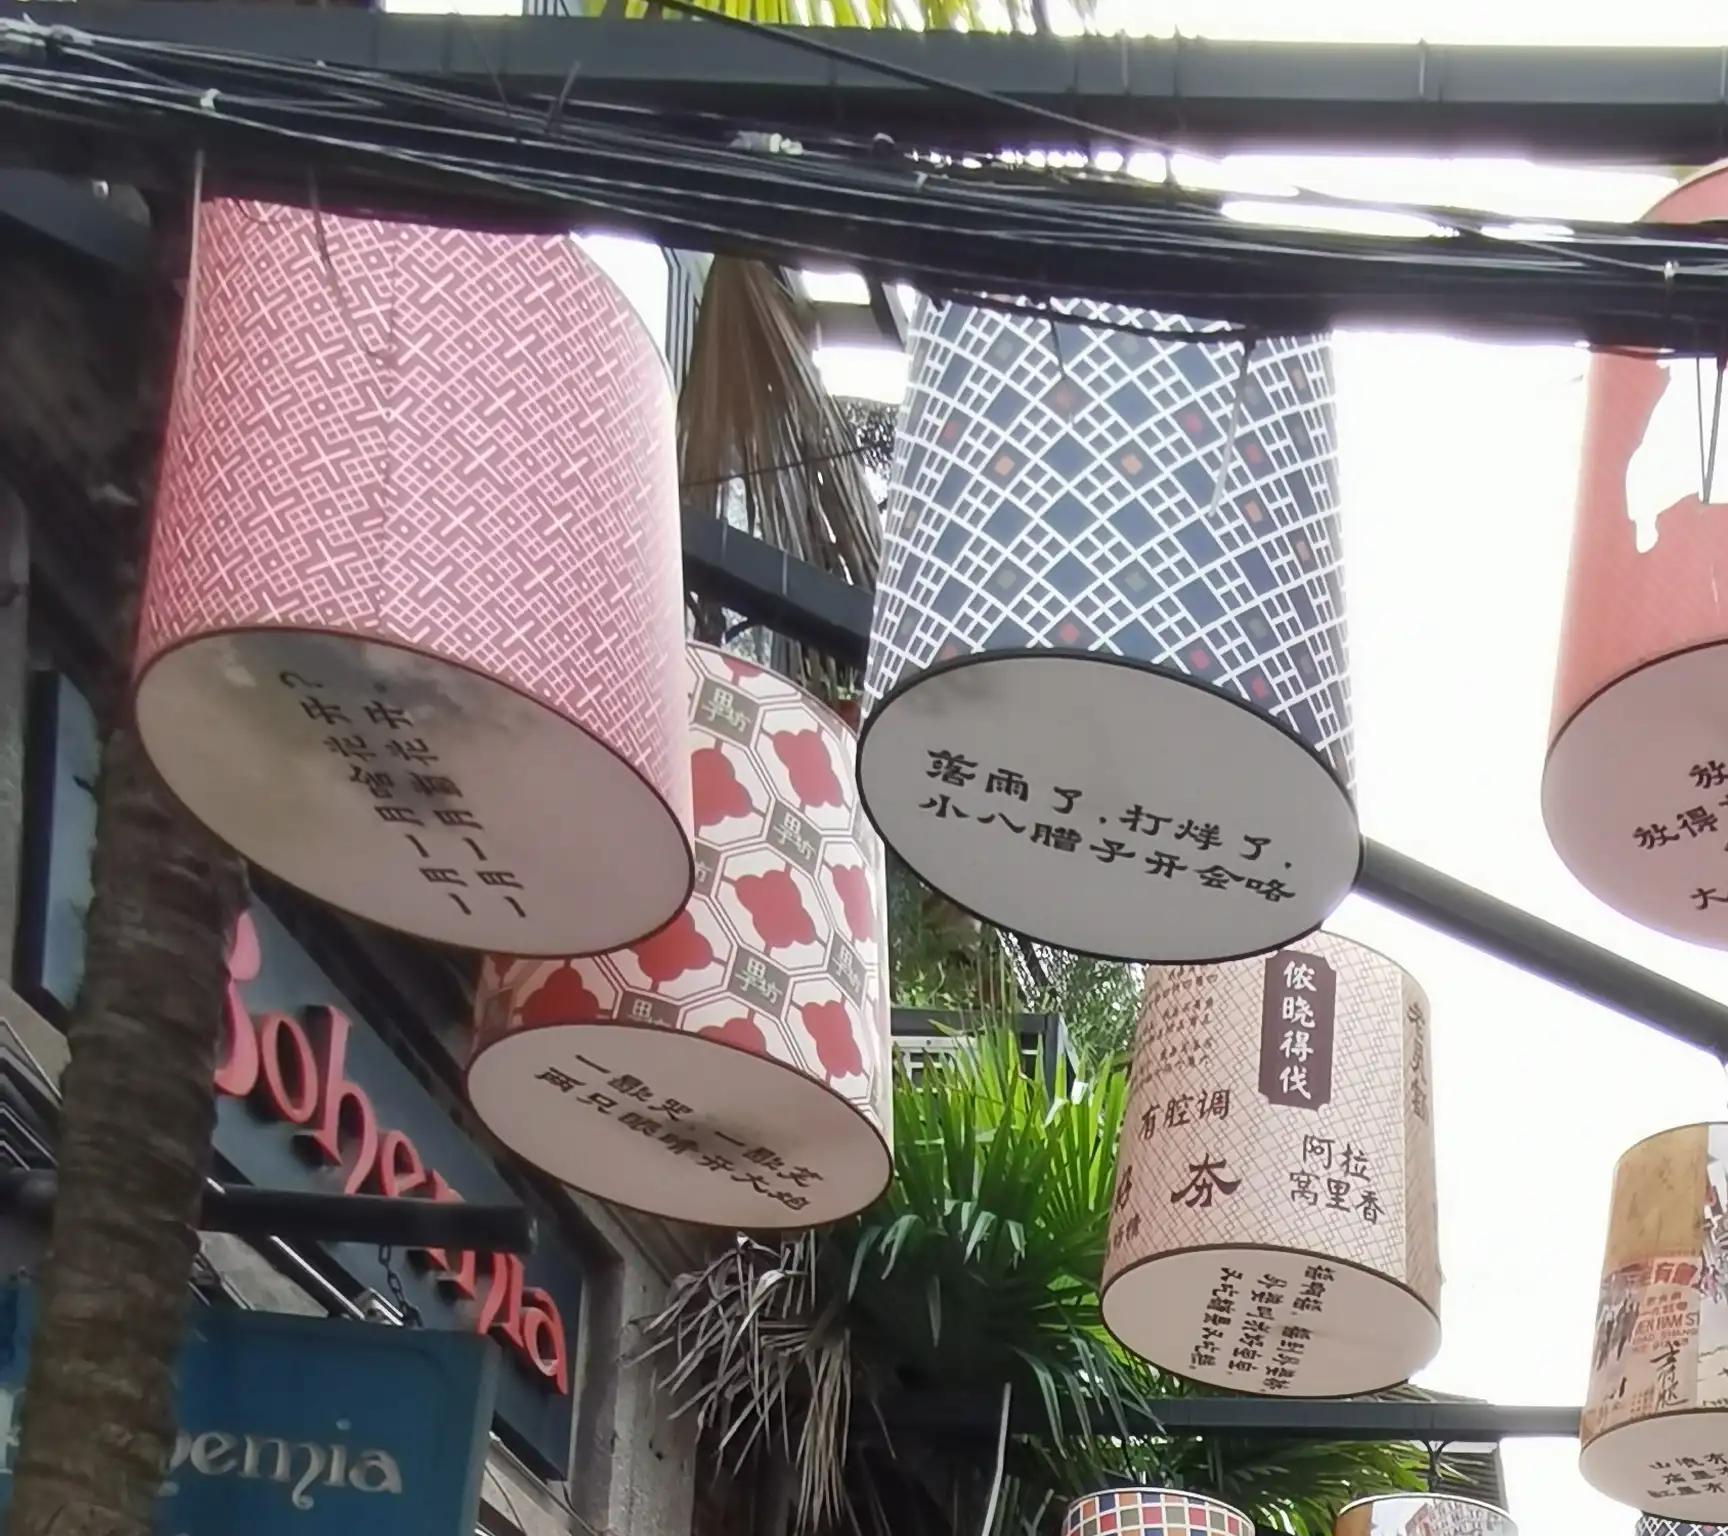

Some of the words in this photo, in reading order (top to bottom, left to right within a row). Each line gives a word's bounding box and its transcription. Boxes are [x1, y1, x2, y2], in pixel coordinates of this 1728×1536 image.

[1278, 960, 1318, 1100] 侬晓得伐
[1139, 1088, 1232, 1141] 有腔调
[1170, 1152, 1242, 1209] 夯
[1302, 1134, 1372, 1183] 阿拉
[1289, 1170, 1385, 1227] 窝里香
